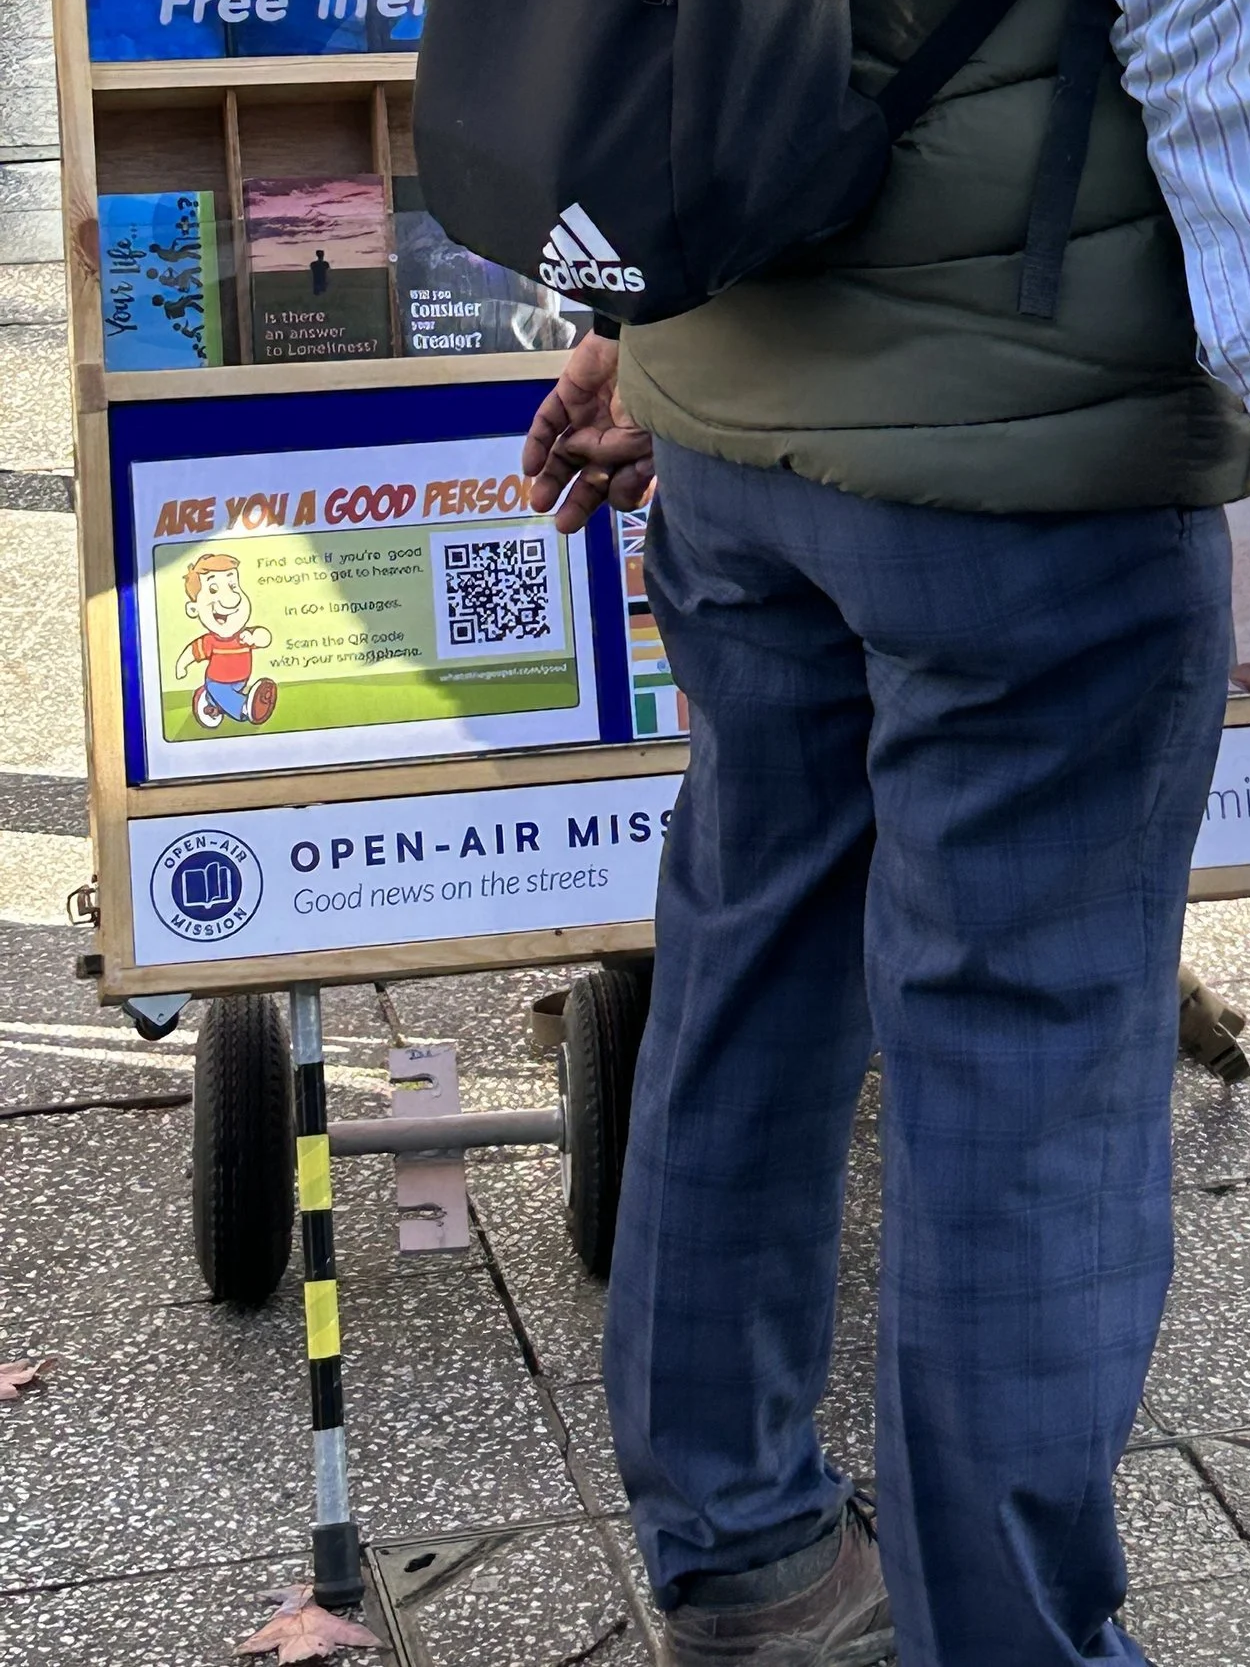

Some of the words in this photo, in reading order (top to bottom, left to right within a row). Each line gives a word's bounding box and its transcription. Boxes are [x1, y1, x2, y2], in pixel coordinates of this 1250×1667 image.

[539, 259, 645, 292] adidas
[106, 281, 138, 337] Your
[265, 312, 276, 323] Is
[282, 311, 325, 323] there
[411, 301, 481, 318] Consider
[265, 330, 283, 340] an
[290, 327, 346, 338] answer
[413, 332, 482, 351] Creator?
[266, 346, 282, 356] to
[289, 339, 377, 355] Loneliness?
[154, 496, 216, 538] ARE
[226, 492, 289, 530] YOU
[293, 490, 316, 527] A
[324, 484, 416, 525] GOOD
[257, 557, 287, 568] Find
[295, 555, 316, 565] out
[339, 549, 381, 565] you're
[388, 547, 422, 561] good
[258, 572, 309, 585] enough
[314, 571, 327, 581] to
[356, 567, 370, 578] to
[284, 605, 297, 616] In
[286, 638, 318, 650] Scan
[322, 636, 344, 647] the
[348, 633, 368, 645] QR
[372, 631, 404, 643] code
[270, 655, 299, 668] with
[303, 653, 333, 668] your
[164, 836, 247, 869] OPEN-AIR
[290, 822, 540, 872] OPEN-AIR
[294, 883, 363, 914] Good
[371, 883, 434, 908] news
[441, 880, 472, 900] on
[481, 871, 520, 897] the
[526, 864, 609, 893] streets
[171, 907, 247, 936] MISSION
